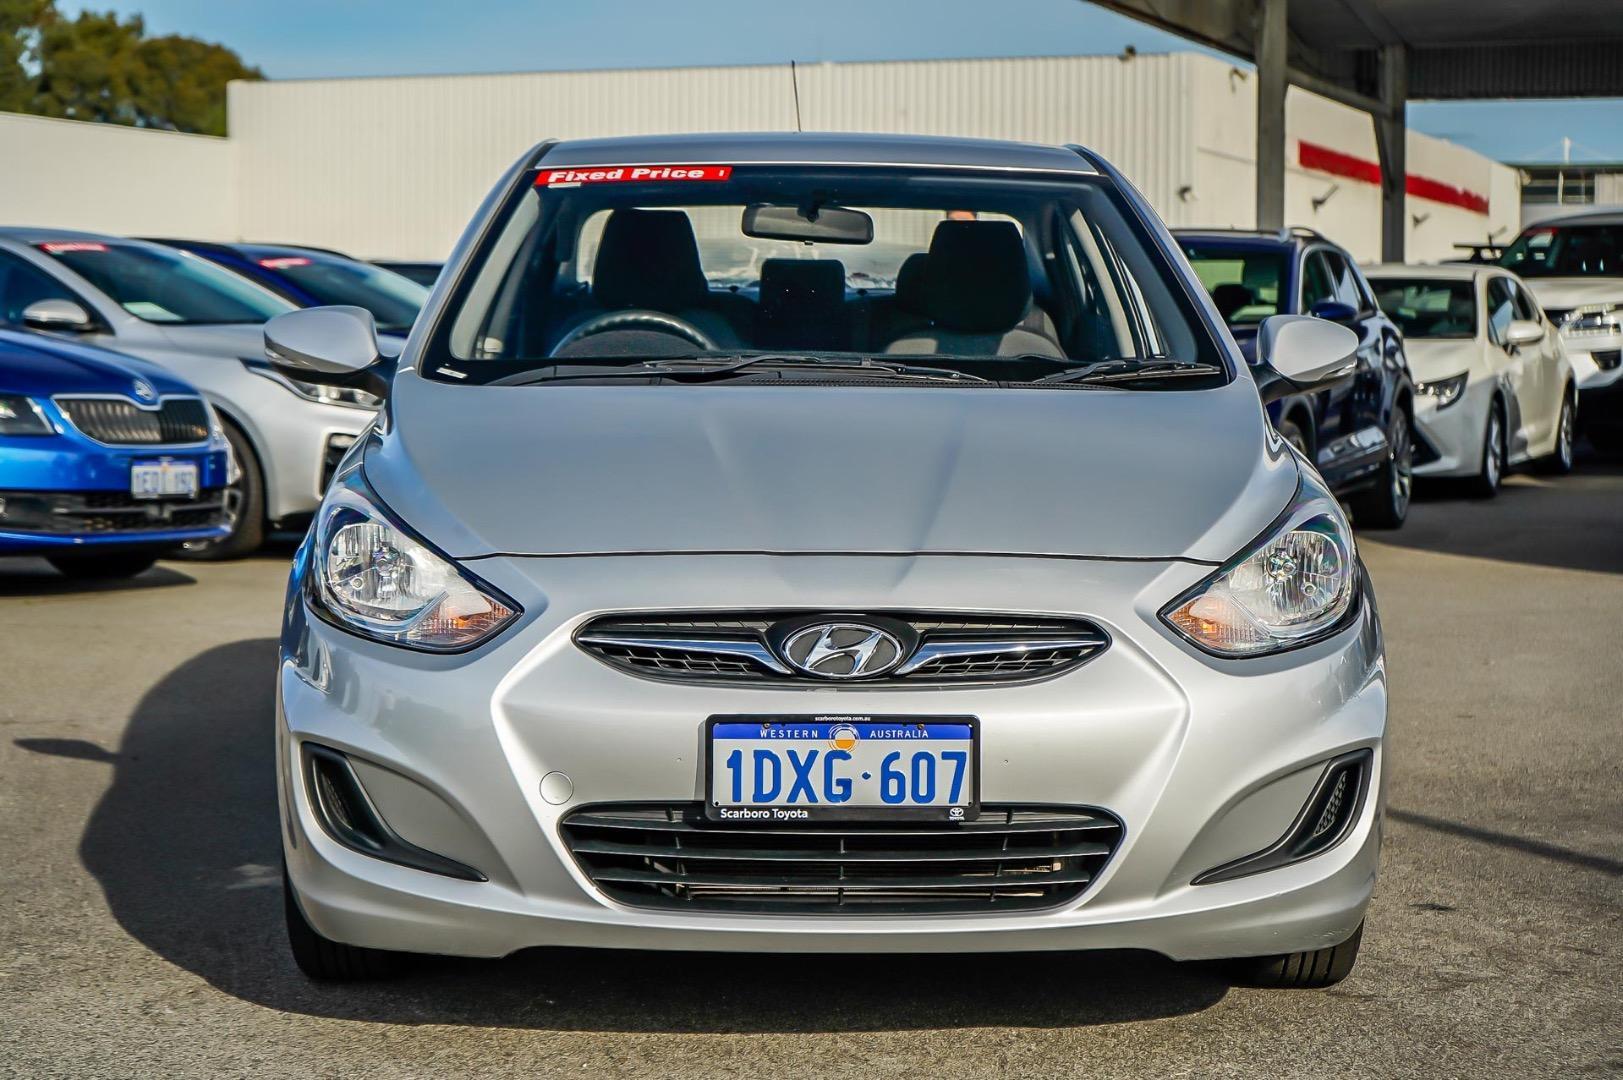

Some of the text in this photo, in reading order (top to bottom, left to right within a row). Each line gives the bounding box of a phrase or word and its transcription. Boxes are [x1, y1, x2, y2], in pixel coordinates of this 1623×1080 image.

[548, 167, 705, 183] Fixed Price
[759, 729, 929, 739] WESTERN AUSTRALIA
[720, 808, 809, 821] Scarboro Toyota
